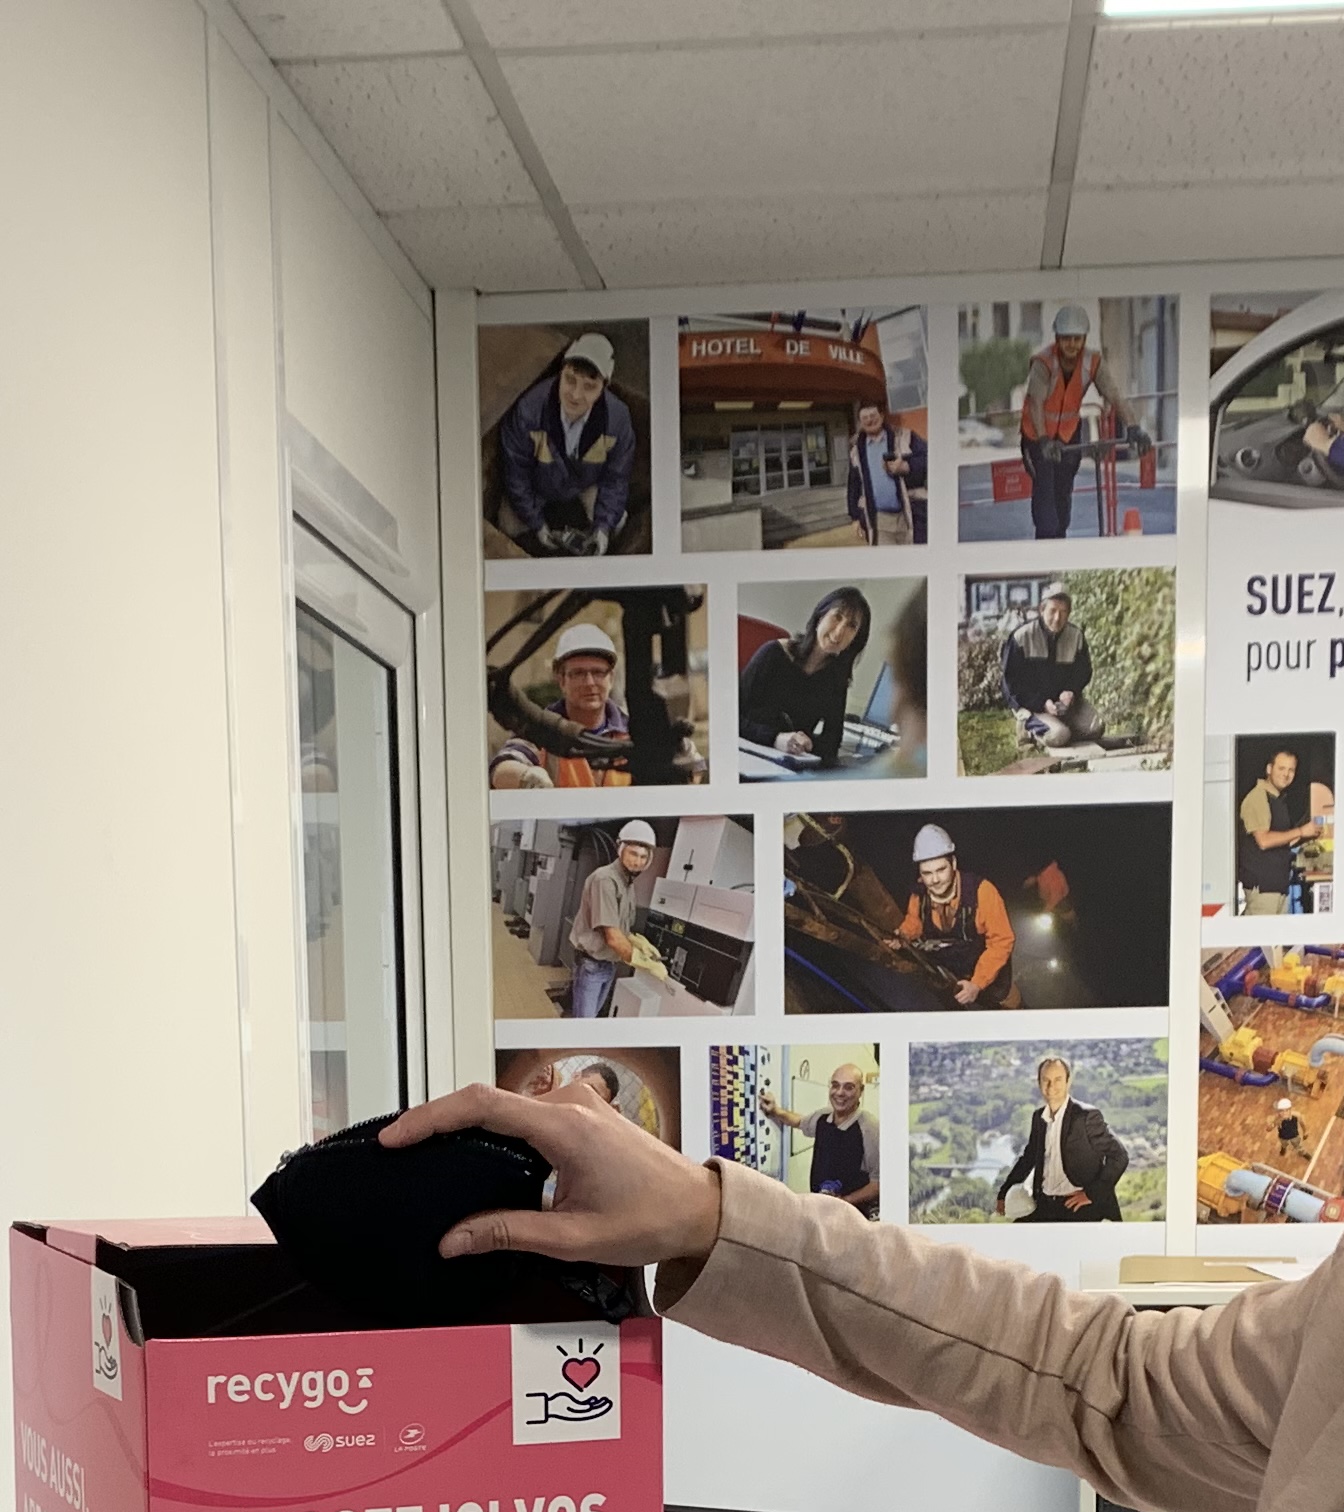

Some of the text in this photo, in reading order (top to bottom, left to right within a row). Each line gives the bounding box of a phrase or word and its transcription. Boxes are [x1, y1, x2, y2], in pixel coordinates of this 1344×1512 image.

[691, 338, 865, 365] HOTEL DE VILLE
[1245, 572, 1344, 620] SUEZ,
[1245, 634, 1317, 682] pour
[207, 1369, 351, 1410] recygo
[20, 1421, 48, 1484] VOUS
[335, 1434, 376, 1448] suez
